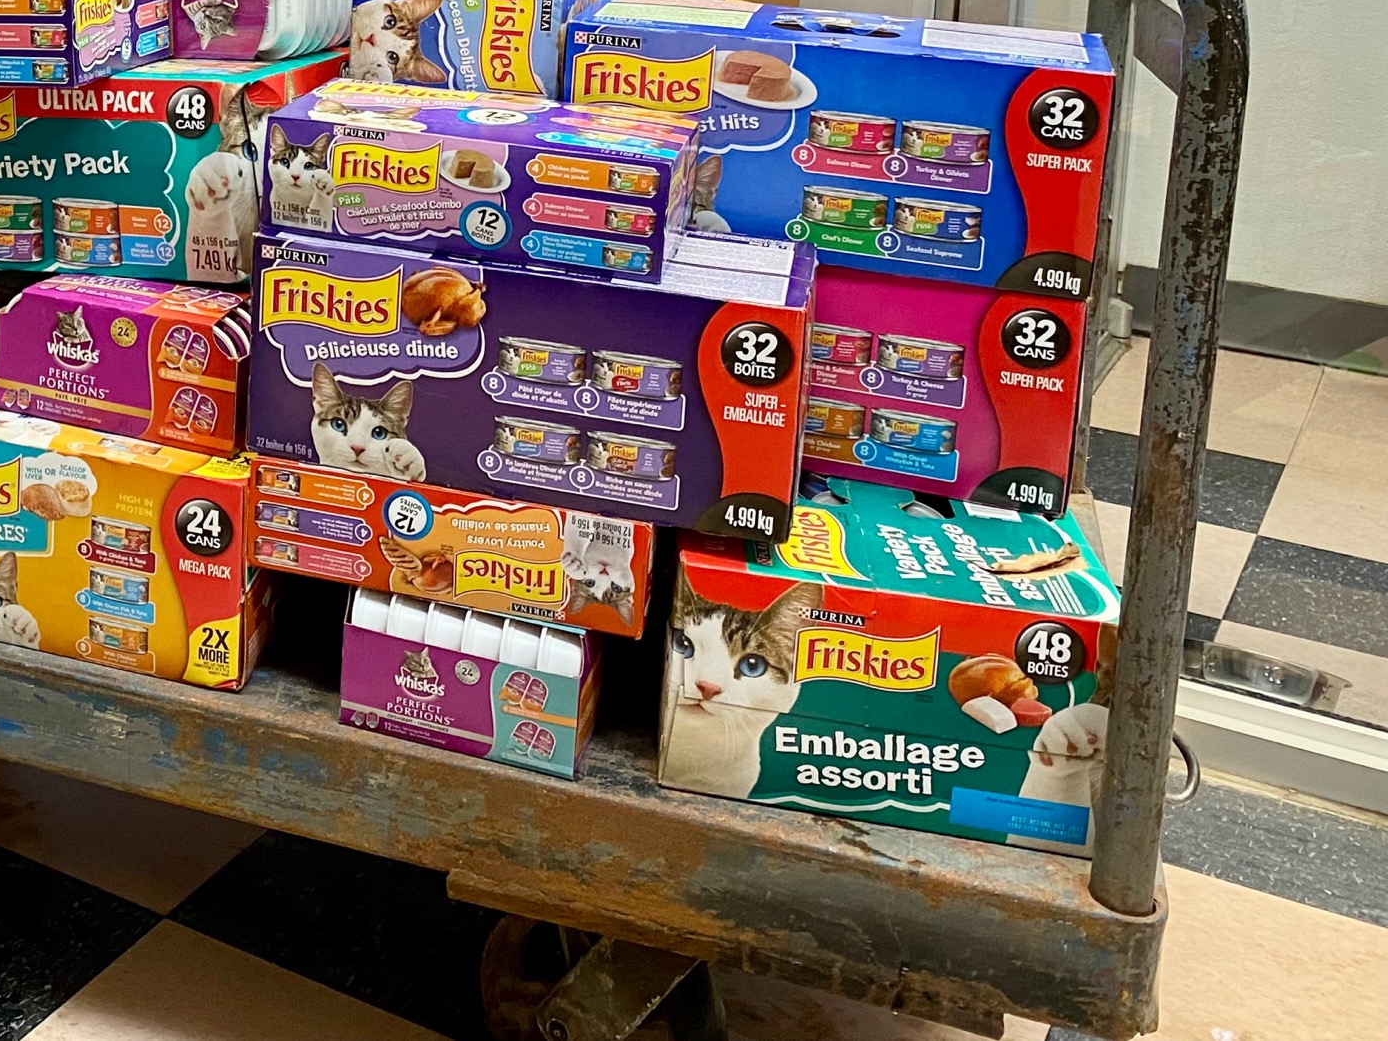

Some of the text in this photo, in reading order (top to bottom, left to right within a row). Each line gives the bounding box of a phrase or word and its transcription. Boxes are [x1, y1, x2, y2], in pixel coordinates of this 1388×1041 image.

[589, 35, 638, 47] PURINA
[585, 63, 701, 102] Friskies
[38, 89, 154, 113] ULTRA PACK
[175, 94, 205, 119] 48
[1043, 98, 1085, 128] 32
[176, 119, 205, 130] CANS
[721, 115, 760, 131] Hits
[344, 129, 384, 140] PURINA
[1041, 125, 1083, 141] CANS
[65, 150, 130, 175] Pack
[340, 151, 431, 185] Friskies
[826, 158, 872, 169] Salmon Dinner
[1026, 154, 1091, 173] SUPER PACK
[347, 200, 461, 217] Chicken & Seafood Combo
[477, 211, 499, 230] 12
[275, 248, 326, 265] PURINA
[906, 245, 962, 258] Seafood Supreme
[271, 279, 390, 325] Friskies
[1015, 317, 1056, 348] 32
[47, 341, 100, 364] whiskas
[304, 340, 458, 360] Délicieuse dinde
[735, 331, 777, 364] 32
[1014, 345, 1055, 360] CANS
[49, 367, 95, 385] PERFECT
[734, 361, 775, 379] BOÎTES
[39, 376, 105, 399] PORTIONS
[1000, 372, 1063, 392] SUPER PACK
[745, 393, 778, 408] SUPER
[723, 408, 785, 427] EMBALLAGE
[60, 465, 85, 474] SCALLOP
[116, 503, 153, 517] PROTEIN
[187, 506, 221, 536] 24
[186, 534, 221, 549] CANS
[466, 534, 545, 549] Poultry Lovers
[876, 524, 926, 579] Variety
[178, 559, 230, 579] MEGA PACK
[464, 560, 554, 592] Friskies
[812, 610, 864, 626] PURINA
[202, 628, 229, 650] 2X
[1027, 631, 1071, 662] 48
[198, 648, 229, 664] MORE
[807, 638, 925, 682] Friskies
[1027, 661, 1069, 679] BOÎTES
[394, 674, 445, 697] whiskas
[387, 702, 450, 725] PORTIONS
[396, 697, 441, 713] PERFECT
[775, 726, 985, 769] Emballage
[796, 764, 932, 795] assorti
